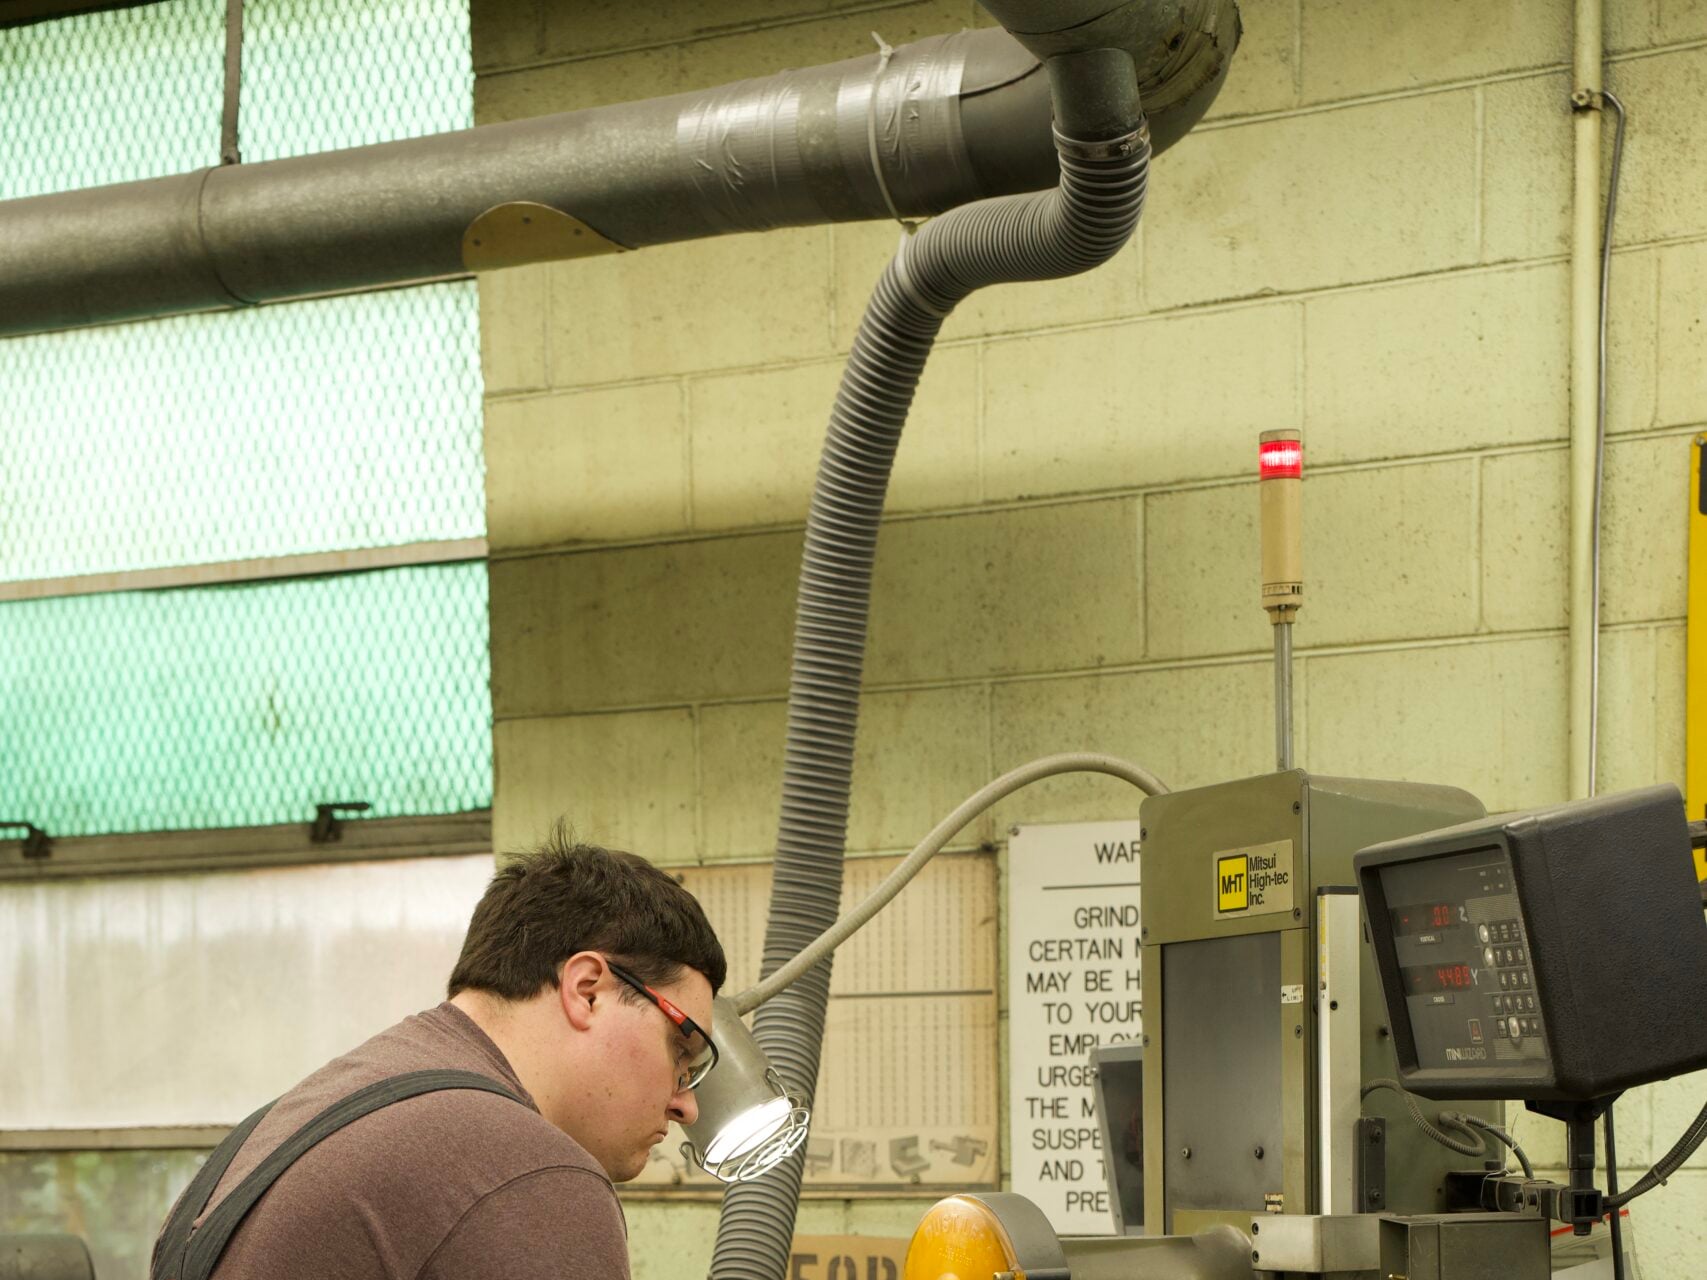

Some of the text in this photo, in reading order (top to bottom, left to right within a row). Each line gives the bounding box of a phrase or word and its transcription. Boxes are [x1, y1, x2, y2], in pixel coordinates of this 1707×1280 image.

[1250, 853, 1276, 871] Mitsui
[1250, 872, 1288, 891] High-tec
[1250, 892, 1265, 905] Inc.
[1074, 905, 1139, 928] GRIND
[1029, 938, 1123, 961] CERTAIN
[1027, 972, 1072, 993] MAY
[1085, 970, 1113, 992] BE
[1042, 1001, 1142, 1024] TO YOUR
[1025, 1097, 1069, 1118] THE
[1032, 1128, 1102, 1150] SUSPE
[1039, 1160, 1083, 1181] AND
[1066, 1191, 1109, 1213] PRE
